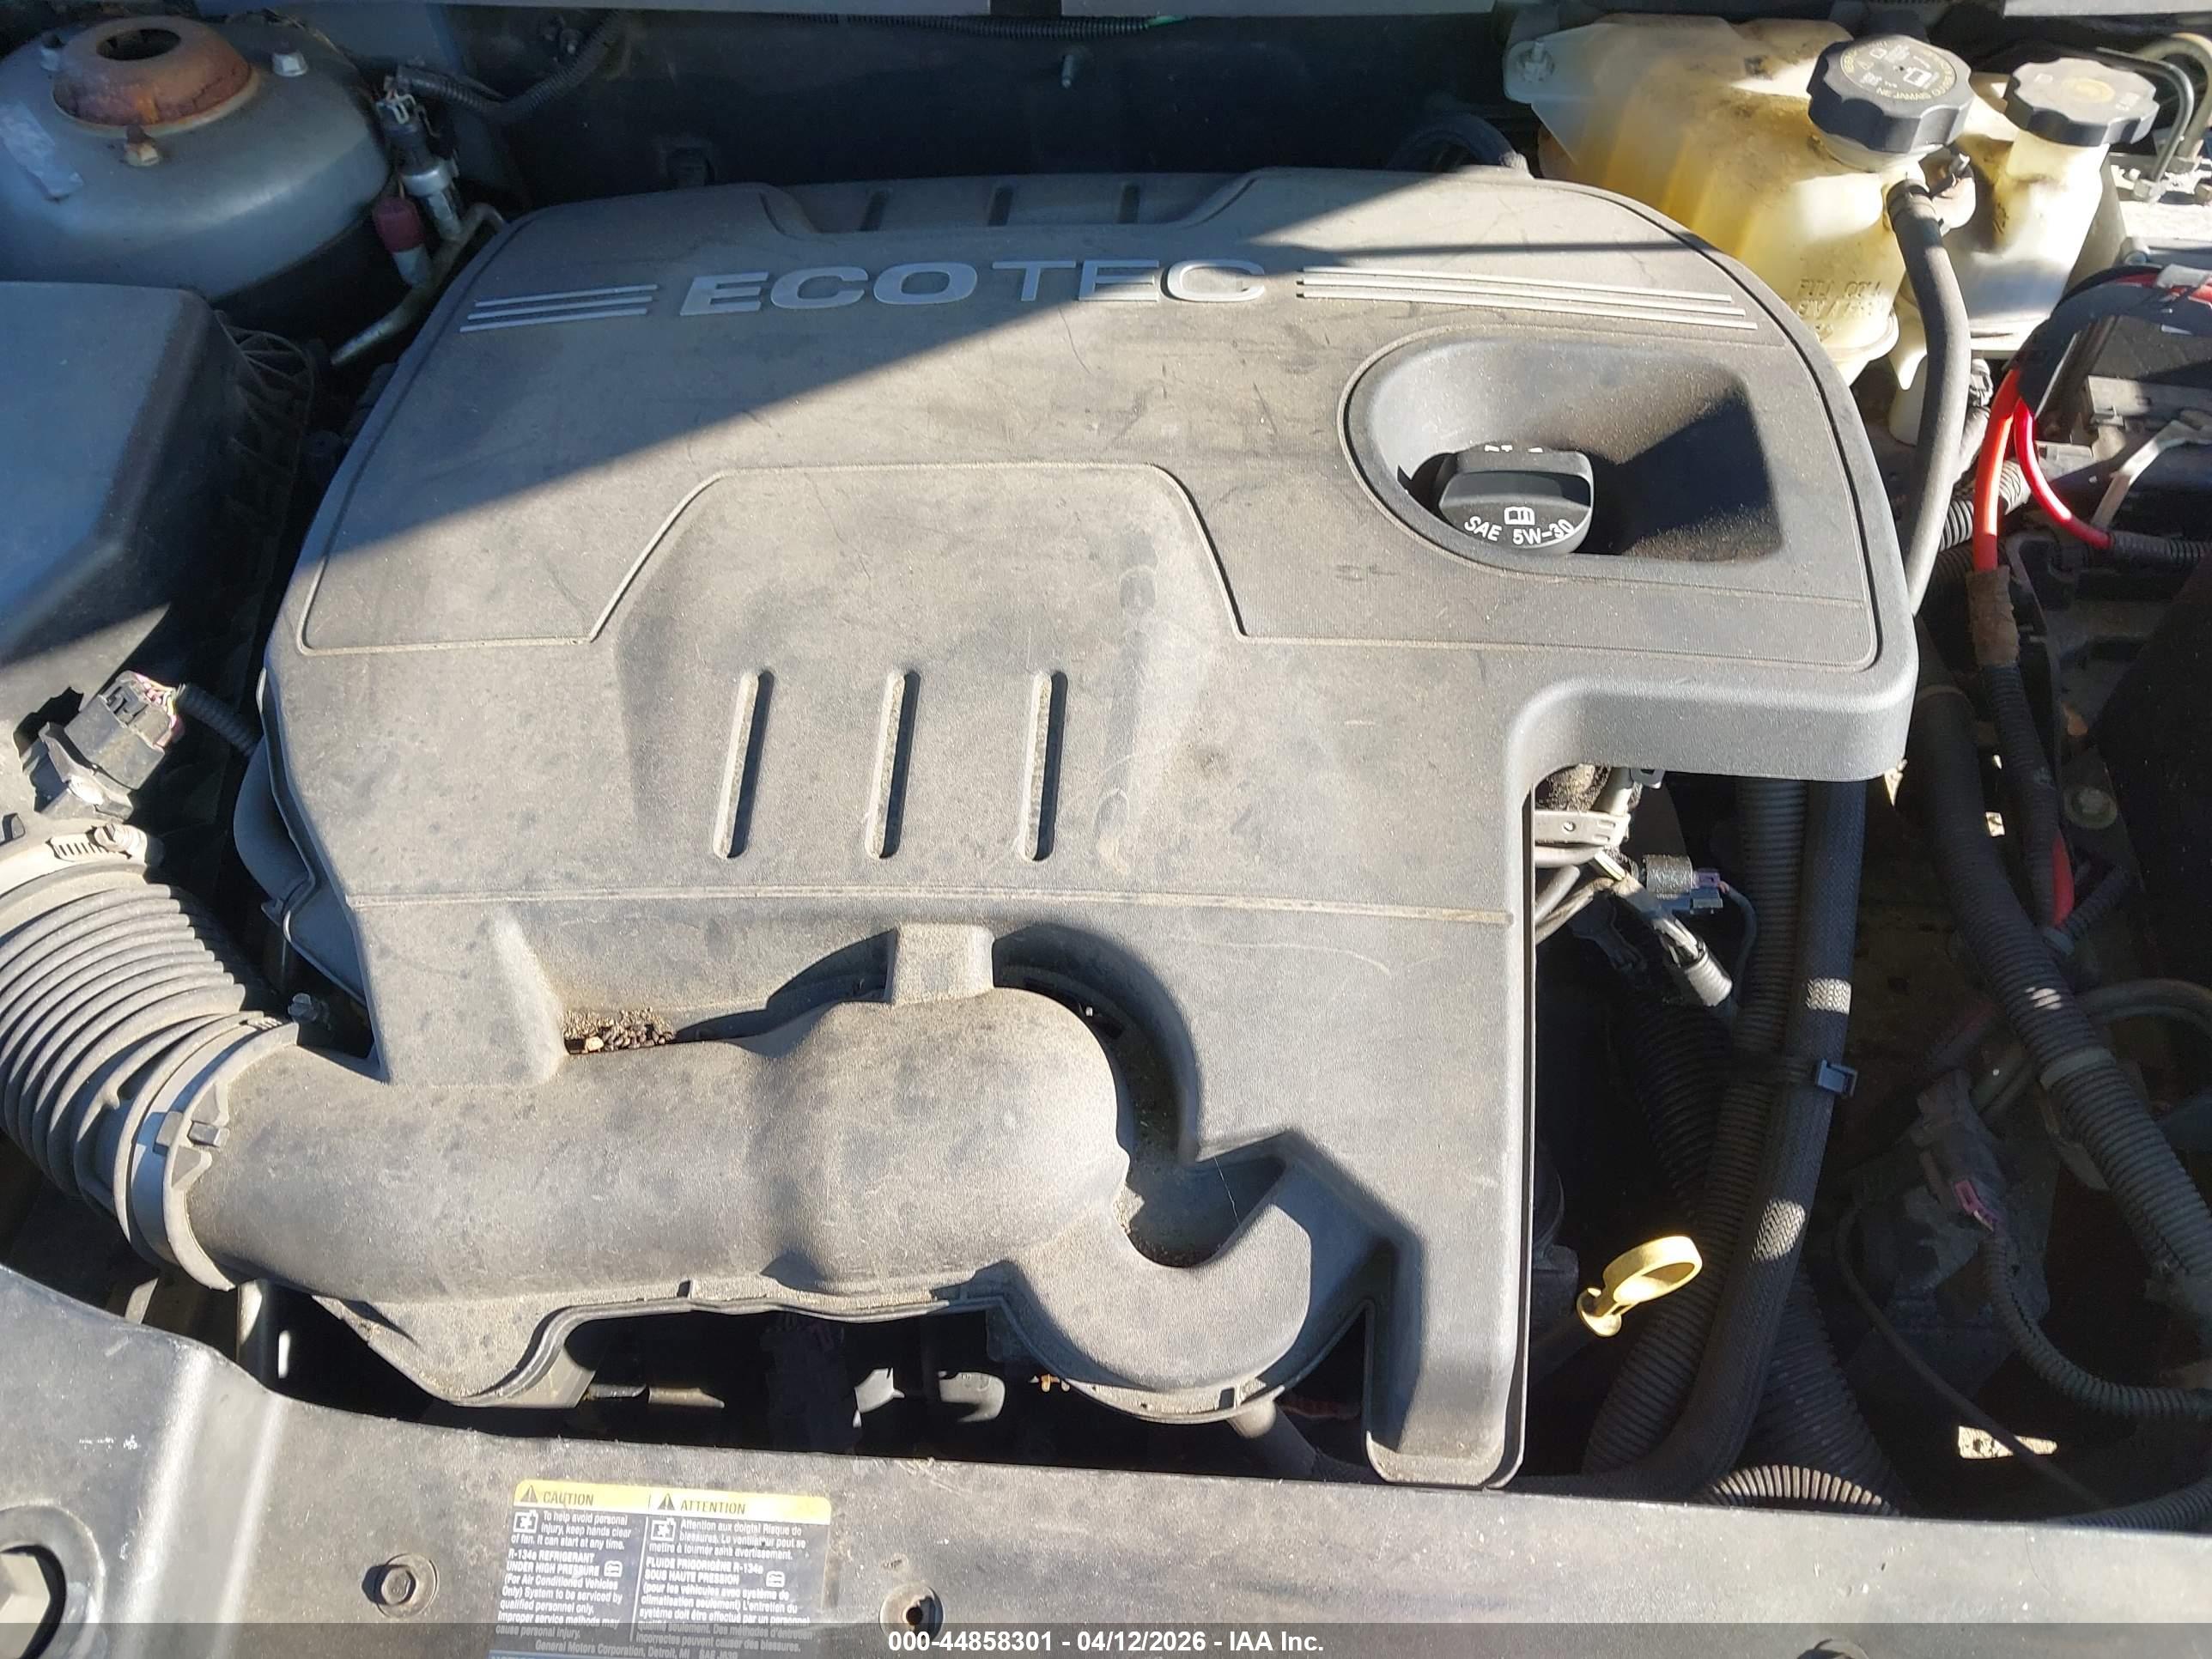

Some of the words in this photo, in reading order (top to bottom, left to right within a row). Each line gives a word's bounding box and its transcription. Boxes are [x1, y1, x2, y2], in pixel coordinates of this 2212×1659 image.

[679, 258, 1265, 316] ECOTEC
[1464, 516, 1503, 542] SAE
[1512, 519, 1574, 545] 5W-30
[543, 1491, 593, 1506] CAUTION
[680, 1499, 746, 1515] ATTENTION
